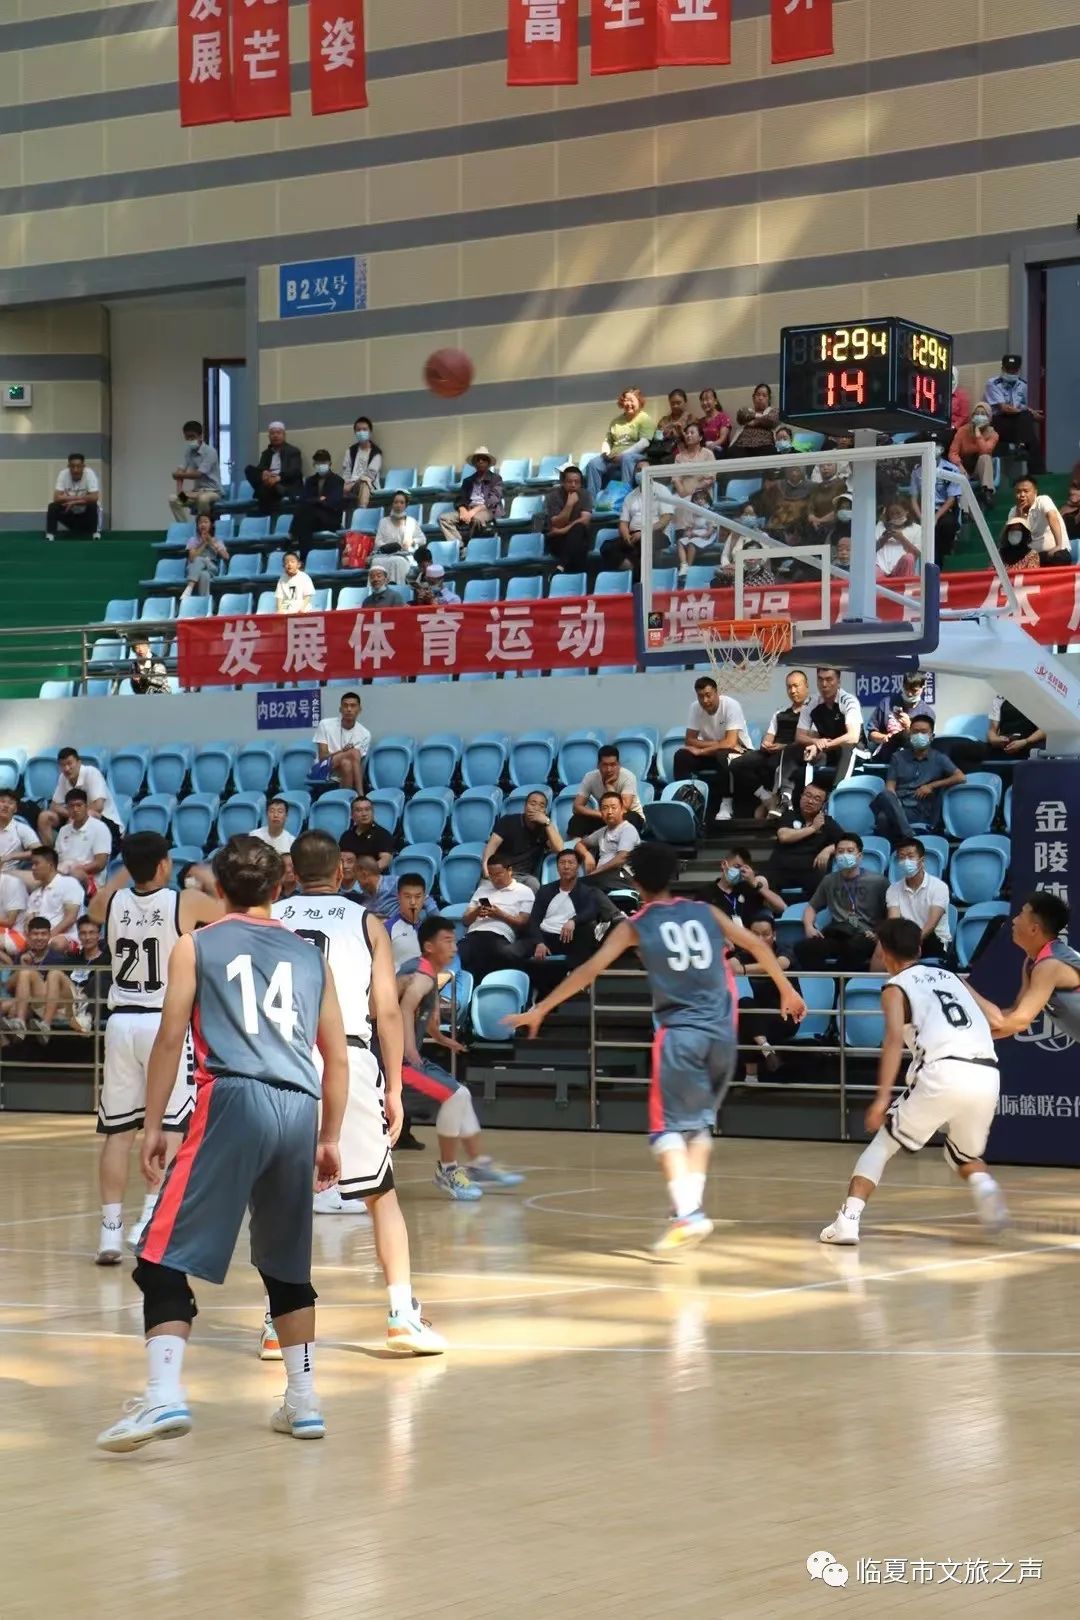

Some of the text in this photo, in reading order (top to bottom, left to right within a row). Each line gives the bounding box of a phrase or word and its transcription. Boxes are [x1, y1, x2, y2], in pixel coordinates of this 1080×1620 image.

[243, 0, 281, 80] 芒
[321, 17, 356, 72] 姿
[286, 274, 348, 301] B2双号
[826, 369, 864, 408] 14
[915, 375, 936, 414] 14
[288, 585, 297, 600] 7
[218, 599, 607, 678] 发展体育运动
[257, 699, 310, 721] 内B2双号
[280, 905, 346, 920] 马旭明
[114, 936, 166, 994] 21
[659, 919, 713, 972] 99
[226, 954, 299, 1042] 14
[932, 988, 973, 1029] 6
[996, 1094, 1080, 1118] 际篮联合
